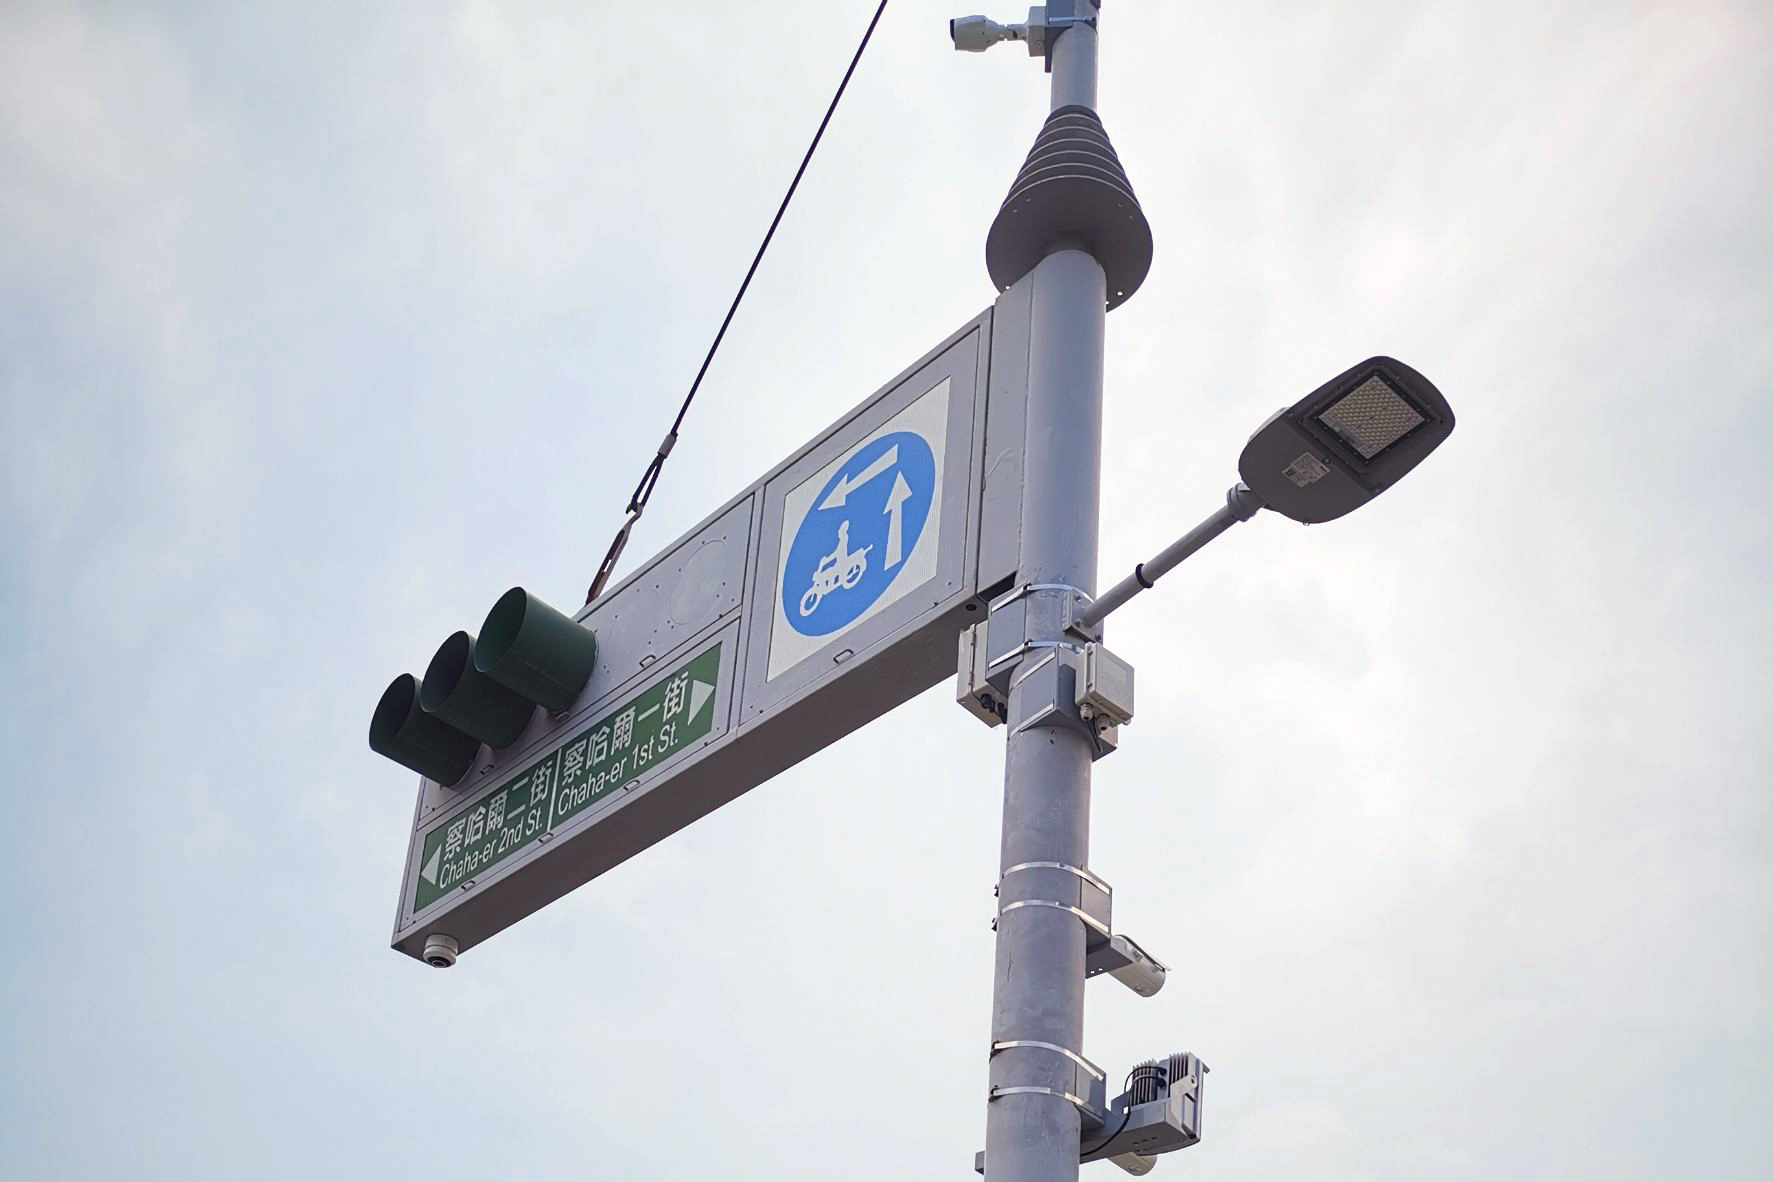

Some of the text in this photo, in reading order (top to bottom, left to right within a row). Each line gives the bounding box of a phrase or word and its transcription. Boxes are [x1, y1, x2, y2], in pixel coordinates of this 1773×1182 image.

[558, 720, 678, 815] Chaha-er 1st St.
[562, 670, 689, 786] 察哈爾一街
[440, 806, 542, 889] Chaha-er 2nd St.
[444, 760, 553, 861] 察哈爾二街
